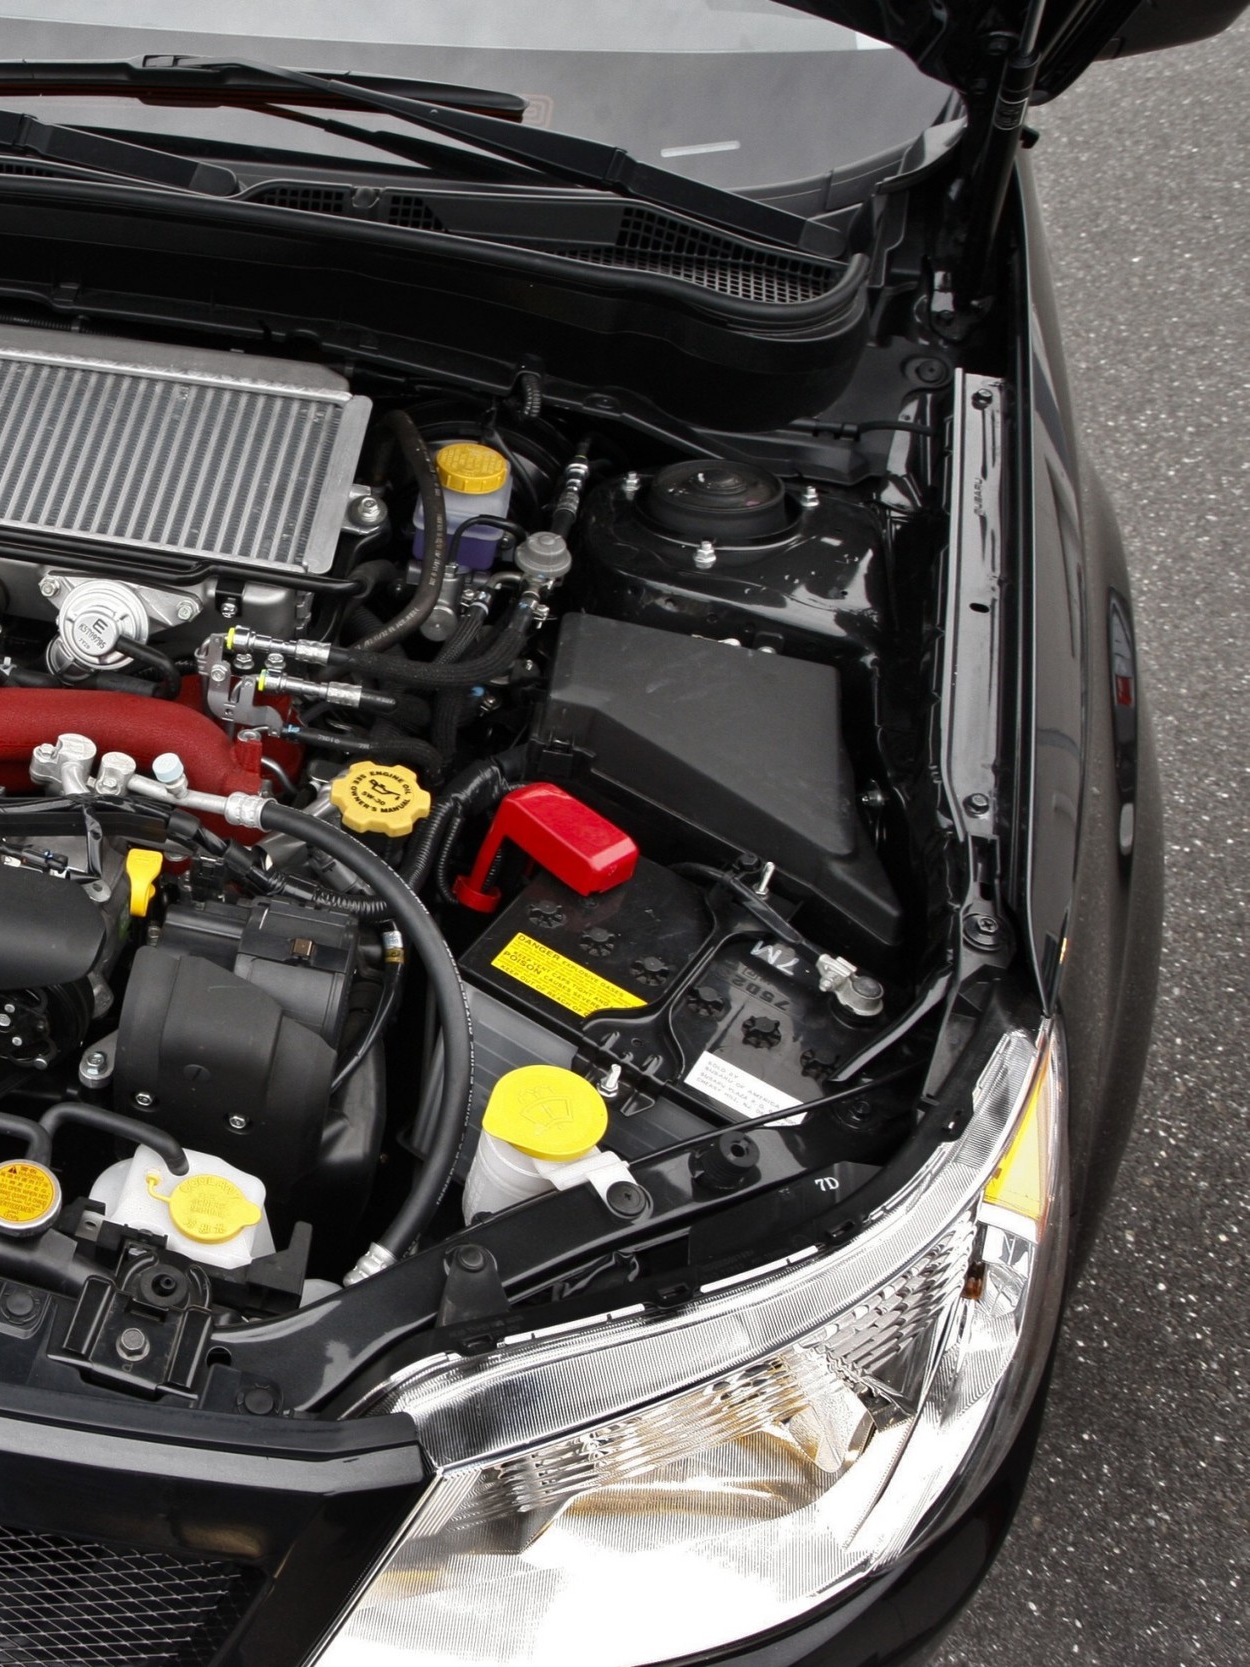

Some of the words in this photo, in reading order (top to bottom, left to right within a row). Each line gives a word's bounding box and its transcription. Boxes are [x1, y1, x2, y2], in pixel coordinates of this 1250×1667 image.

[92, 618, 108, 634] E
[353, 774, 367, 784] SEE
[369, 771, 405, 784] ENGINE
[402, 784, 412, 794] OIL
[350, 786, 378, 812] OWNER'S
[380, 799, 412, 812] MANUAL
[361, 790, 386, 806] 5W-30
[502, 950, 544, 976] POISON
[544, 974, 572, 994] CAUSES
[513, 951, 532, 963] KEEP
[533, 961, 550, 974] VENT
[551, 972, 570, 985] CAPS
[572, 982, 593, 997] TIGHT
[593, 996, 610, 1007] AND
[517, 935, 562, 961] DANGER
[562, 960, 600, 984] EXPLOSIVE
[600, 982, 625, 998] GASES
[500, 964, 520, 978] KEEP
[520, 976, 535, 986] OUT
[536, 984, 547, 992] OF
[547, 990, 572, 1008] REACH
[572, 1005, 584, 1014] OF
[708, 1061, 726, 1073] SOLD
[729, 1071, 739, 1079] BY
[696, 1077, 722, 1092] CHERRY
[700, 1072, 725, 1088] SUBARU
[728, 1087, 748, 1100] PLAZA
[705, 1066, 734, 1084] SUBARU
[748, 1090, 780, 1109] AMERICA
[178, 1176, 242, 1200] COOLANT
[814, 1176, 840, 1192] 7D
